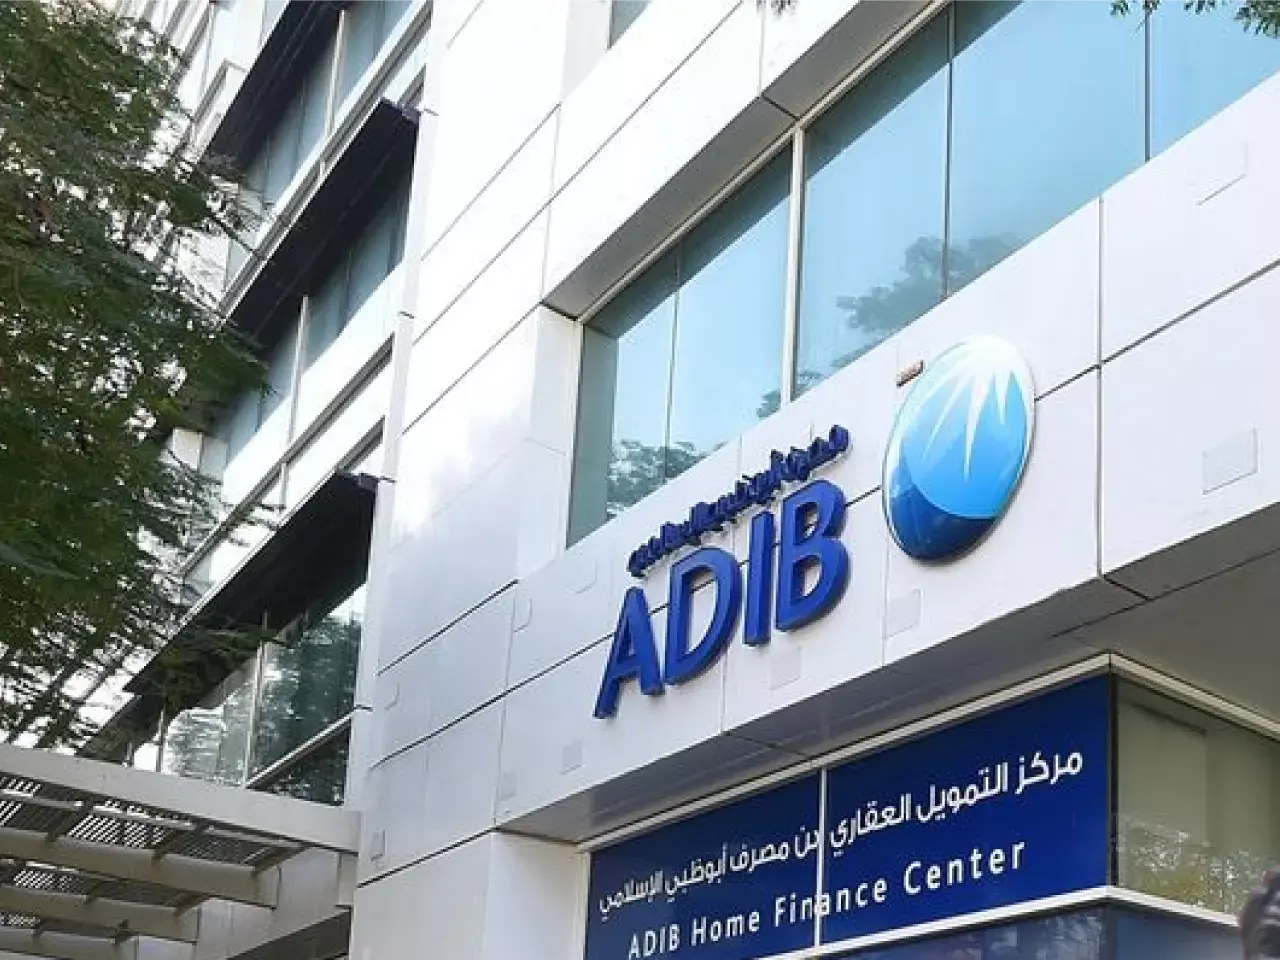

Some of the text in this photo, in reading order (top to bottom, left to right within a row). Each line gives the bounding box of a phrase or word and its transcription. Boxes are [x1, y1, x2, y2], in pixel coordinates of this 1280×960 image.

[594, 479, 851, 719] ADIB
[916, 762, 1009, 822] التمويل
[1015, 751, 1084, 794] مركز
[829, 793, 912, 857] العقاري
[729, 842, 789, 873] مصرف
[628, 842, 1026, 960] ADIB Home Finance Center
